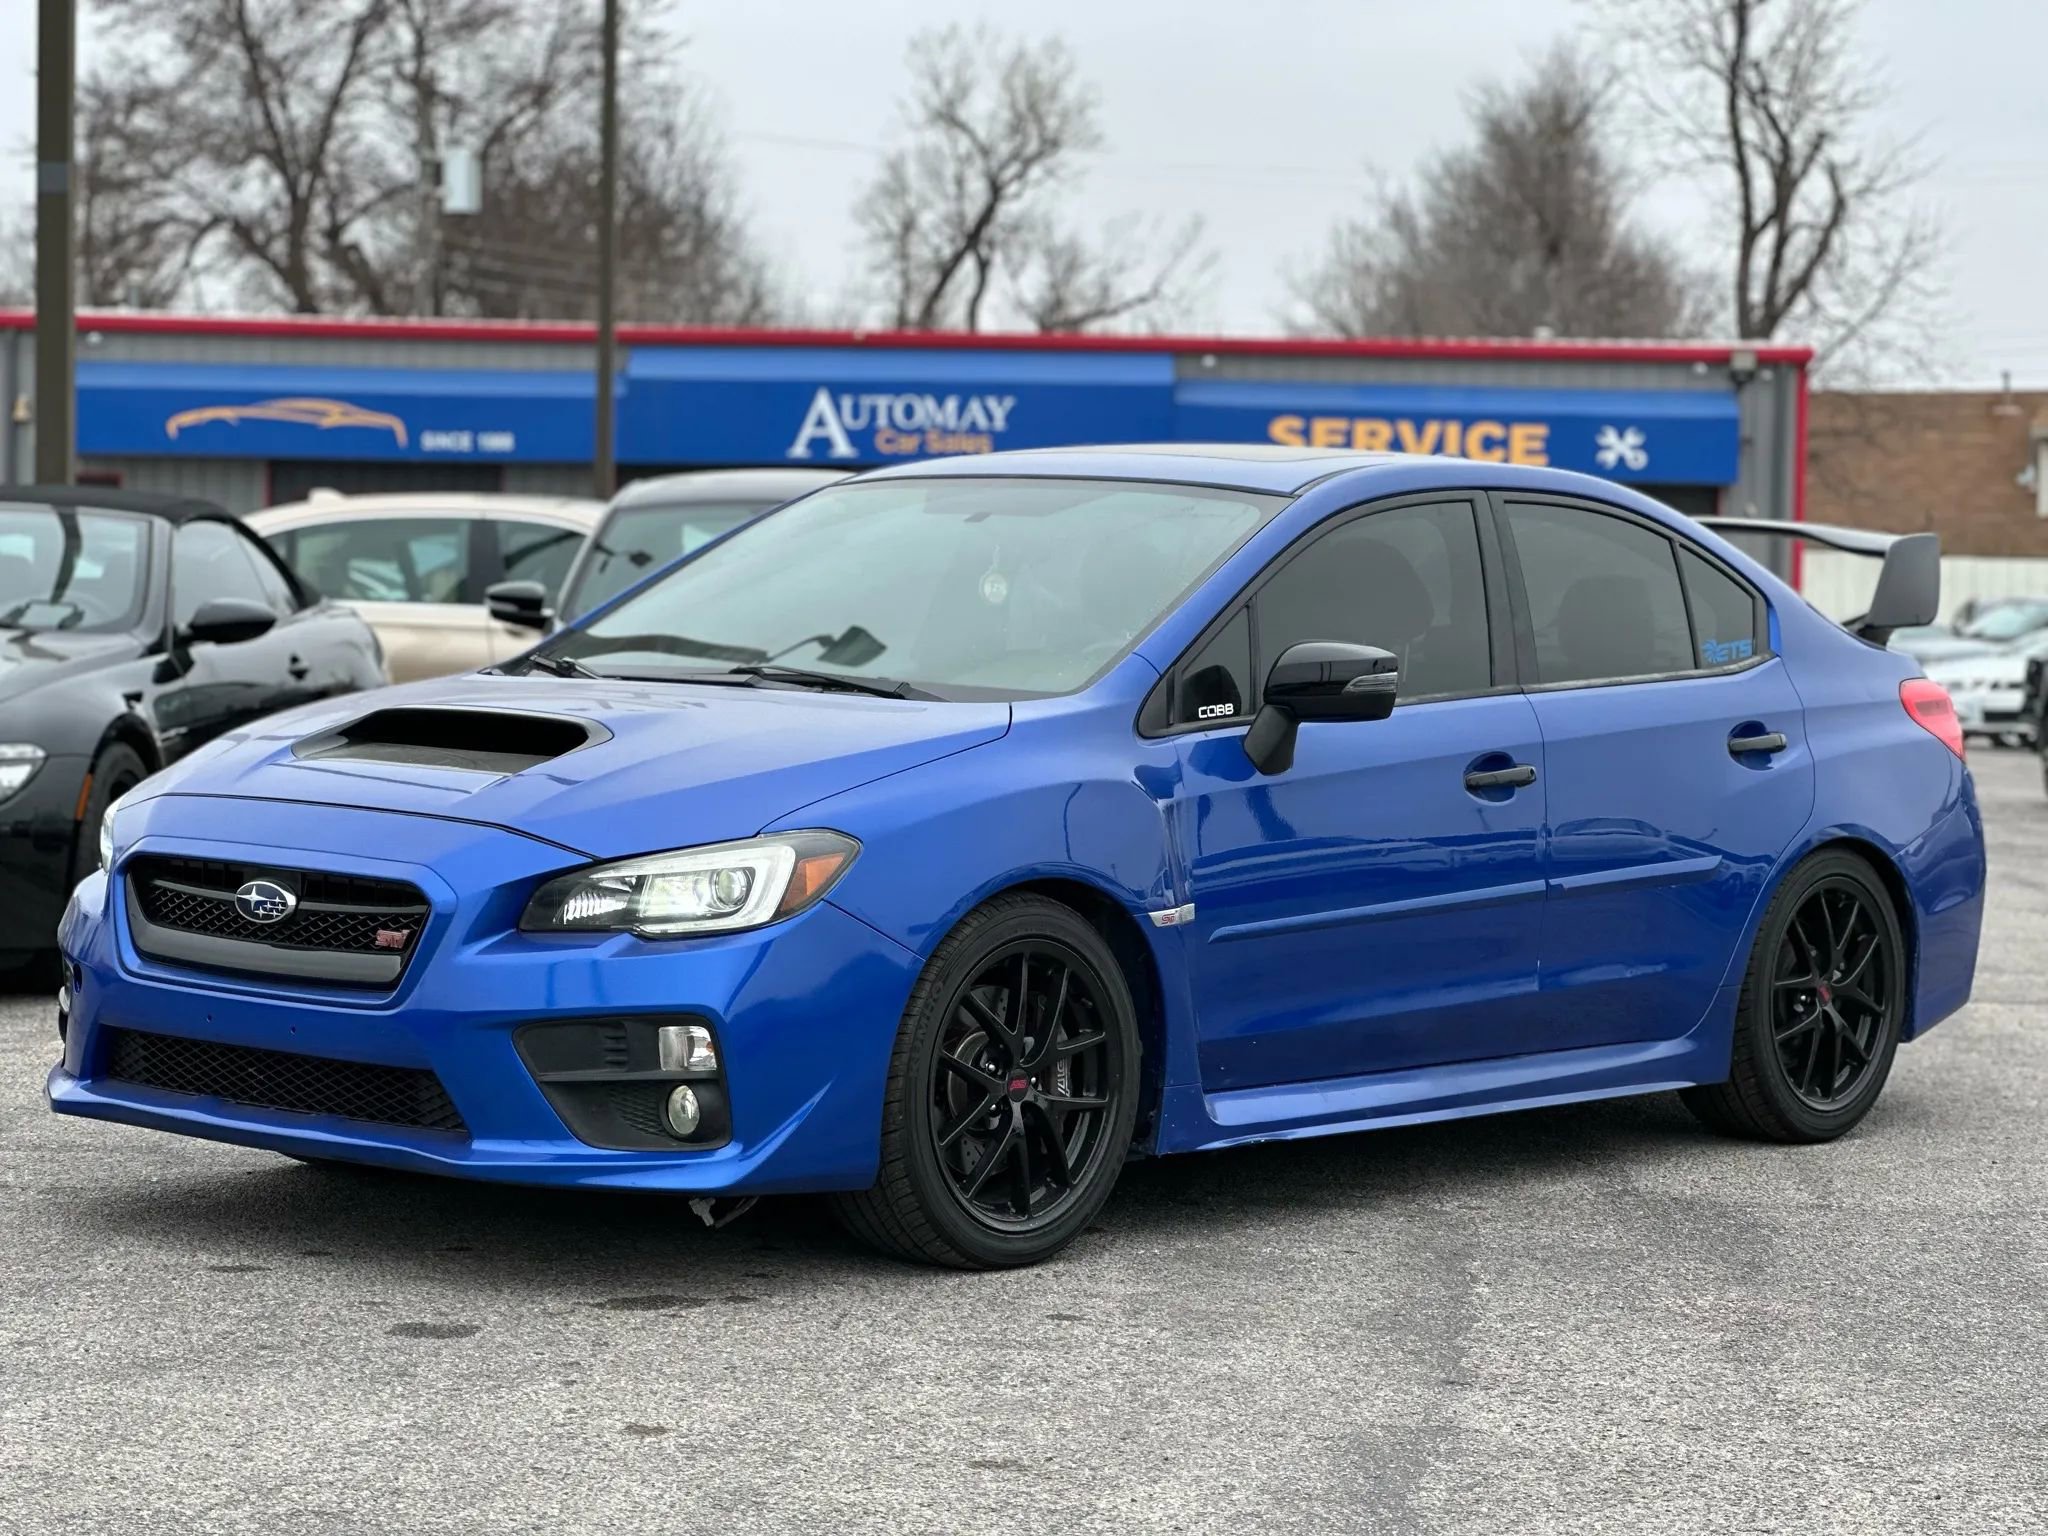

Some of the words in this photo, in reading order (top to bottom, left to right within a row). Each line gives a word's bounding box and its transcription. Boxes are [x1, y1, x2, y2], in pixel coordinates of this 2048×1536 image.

[420, 430, 473, 453] SINCE
[874, 428, 920, 455] Car
[925, 428, 993, 454] Sales
[1268, 414, 1550, 467] SERVICE
[1198, 703, 1234, 719] COBB
